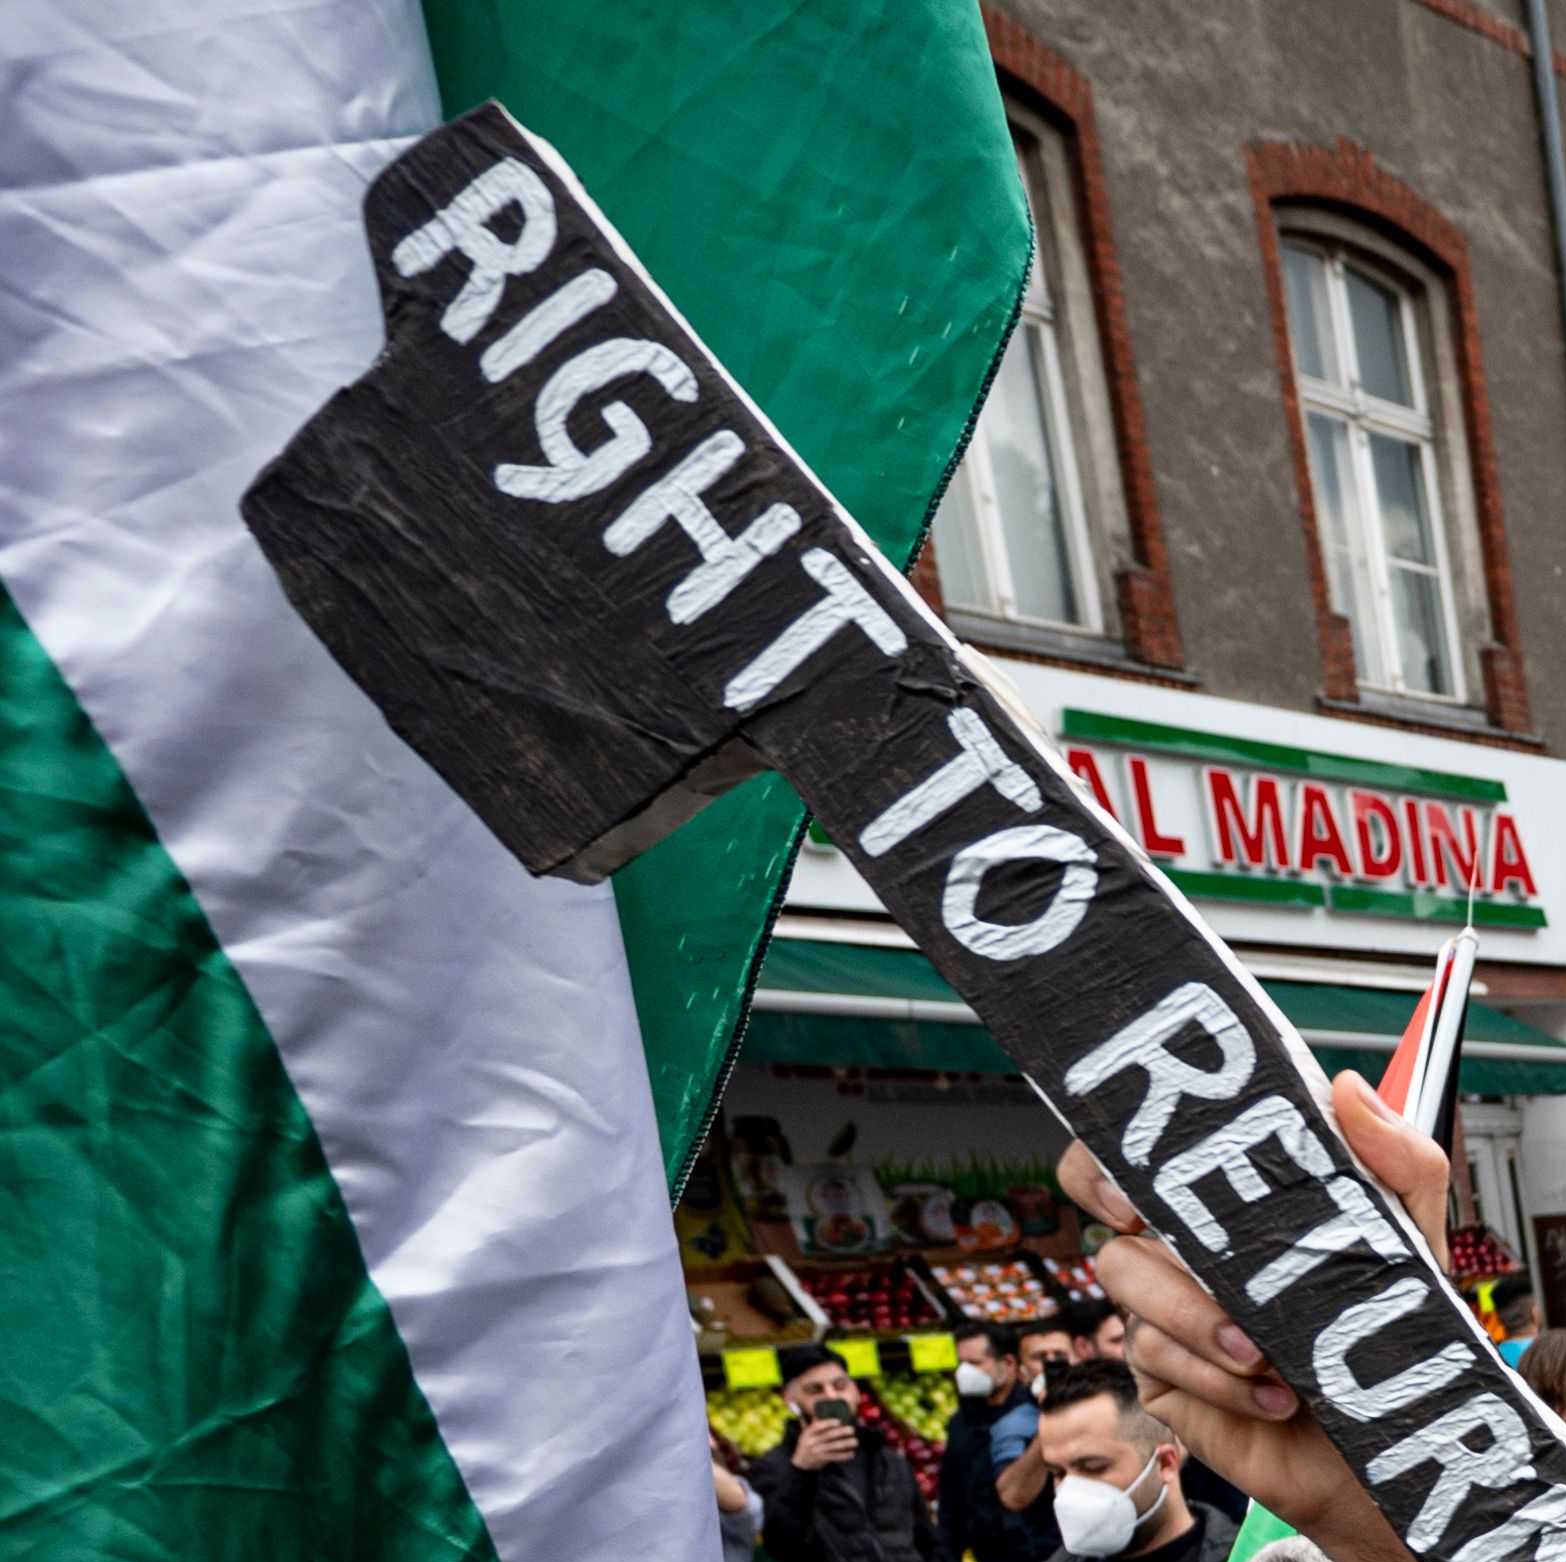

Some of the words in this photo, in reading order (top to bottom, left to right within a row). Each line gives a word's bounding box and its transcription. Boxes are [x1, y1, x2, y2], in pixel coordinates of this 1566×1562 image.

[392, 157, 908, 711] RIGHT
[858, 706, 1099, 961] TO
[1207, 765, 1538, 897] MADINA
